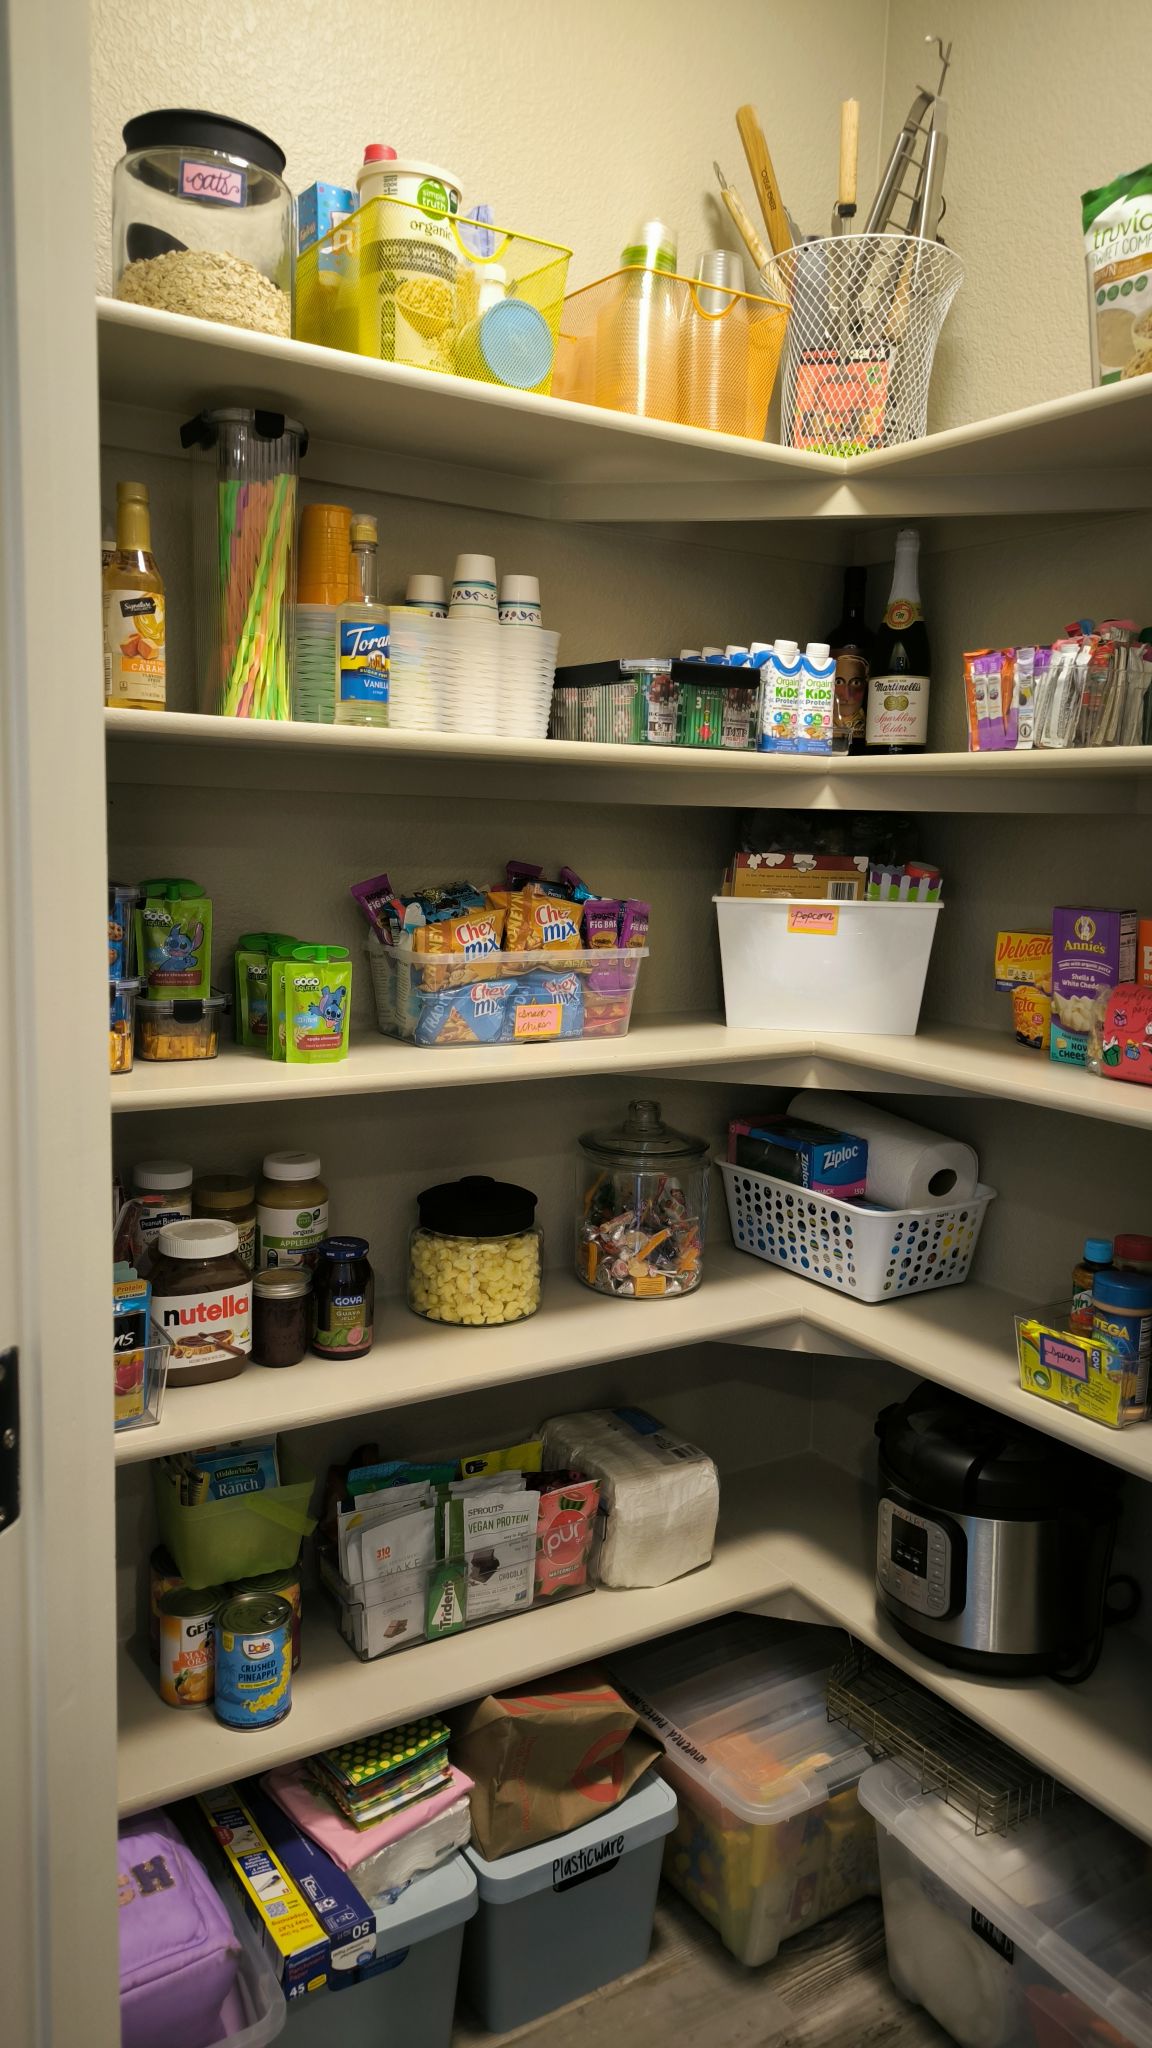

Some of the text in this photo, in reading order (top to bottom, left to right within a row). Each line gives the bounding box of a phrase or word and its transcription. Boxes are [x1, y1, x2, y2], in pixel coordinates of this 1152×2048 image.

[186, 172, 240, 196] oats
[422, 189, 446, 201] simple
[422, 198, 446, 211] truth
[410, 220, 452, 240] organic
[874, 711, 917, 726] Sparkling
[882, 723, 907, 734] Cider
[456, 915, 496, 945] Chex
[543, 921, 578, 943] mix
[465, 933, 501, 962] mix
[1064, 939, 1106, 954] Annie's
[293, 977, 320, 986] GOGO
[543, 973, 577, 994] Chex
[1061, 979, 1080, 987] White
[1071, 973, 1089, 982] Shells
[470, 983, 511, 1000] Chex
[824, 1145, 859, 1170] Ziploc
[800, 1153, 809, 1190] Ziploc
[141, 1219, 162, 1228] Peanut
[116, 1284, 143, 1293] Protein
[335, 1295, 363, 1306] GOYA
[164, 1295, 249, 1327] nutella
[216, 1467, 239, 1479] Hidden
[219, 1479, 259, 1497] Ranch
[467, 1503, 504, 1517] SPROUTS
[468, 1514, 529, 1534] VEGAN PROTEIN
[376, 1546, 391, 1558] 310
[439, 1580, 454, 1632] Trident
[248, 1641, 271, 1653] Dole
[241, 1659, 276, 1673] CRUSHED
[238, 1667, 278, 1681] PINEAPPLE
[552, 1835, 624, 1883] Plasticware
[271, 1911, 309, 1926] Dispensing
[278, 1923, 295, 1932] FLAT
[352, 1921, 370, 1939] 50
[289, 1983, 305, 1997] 45
